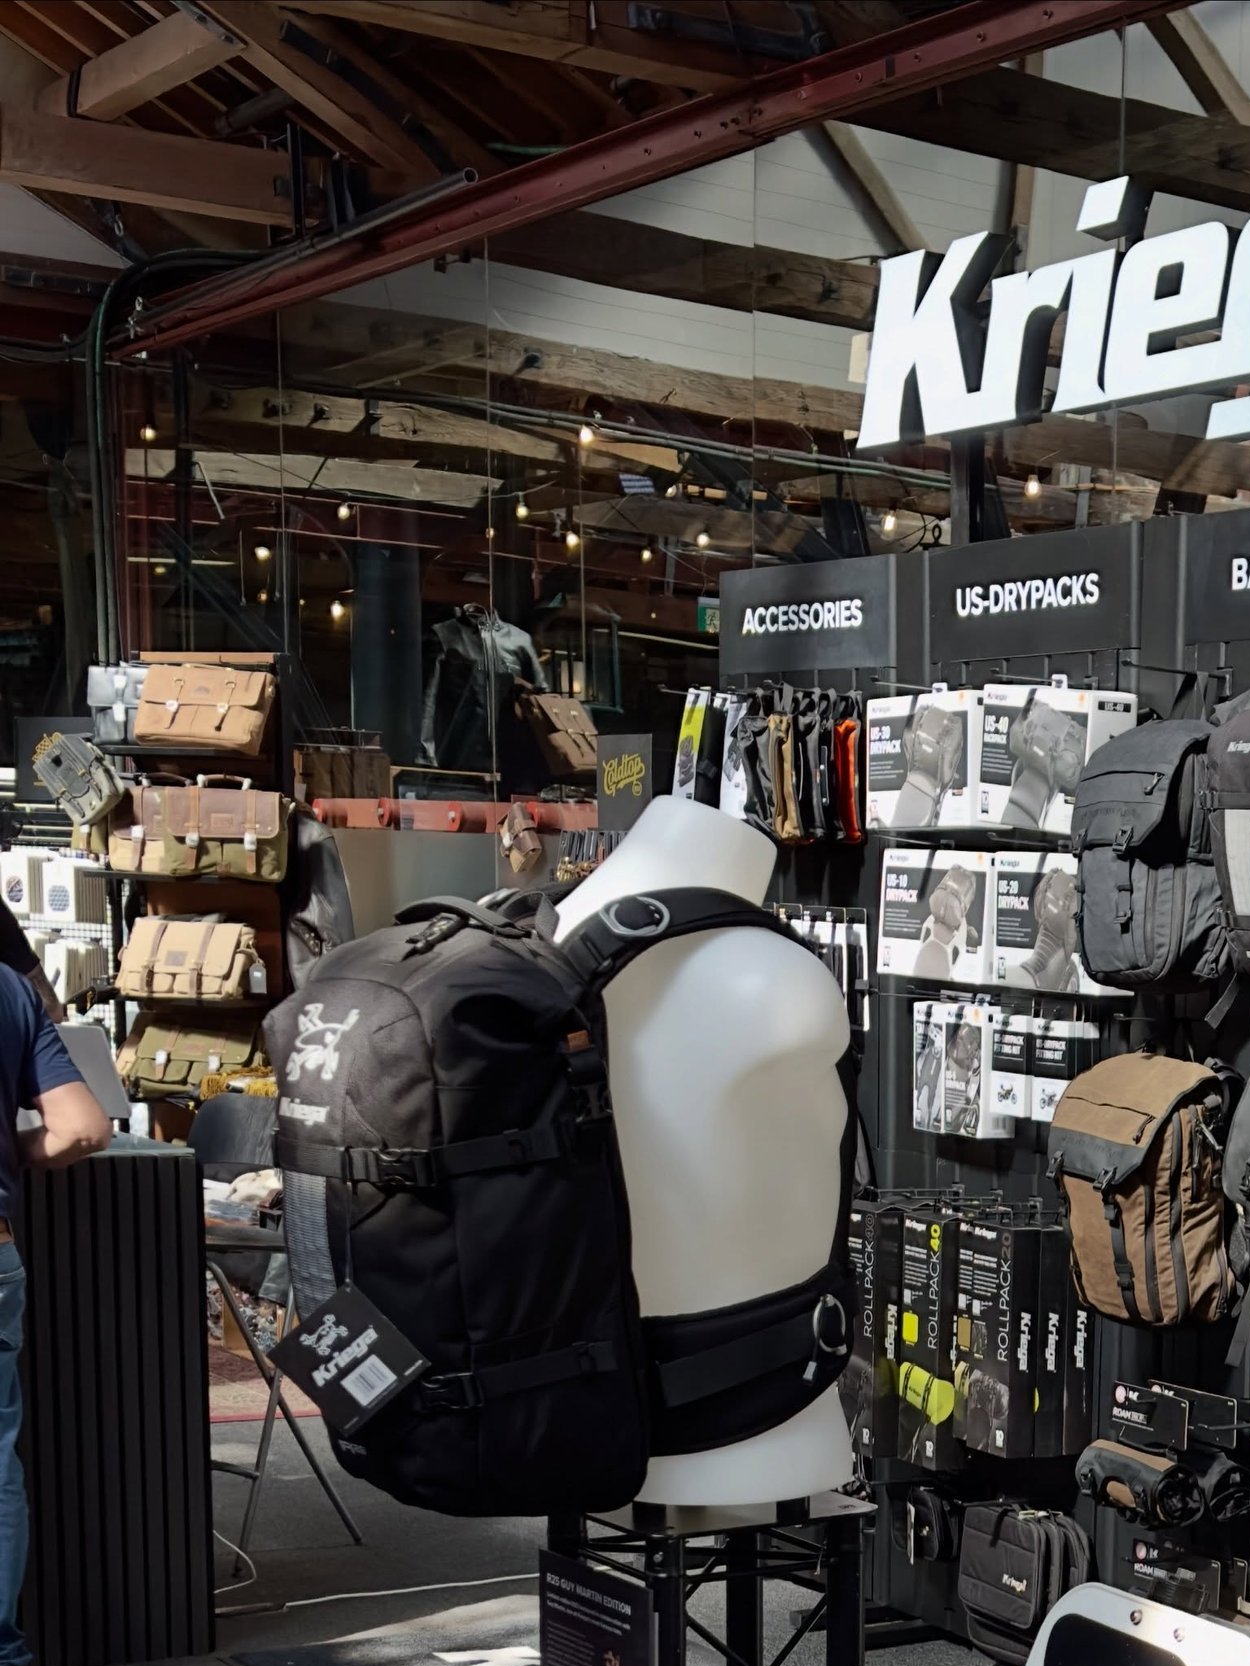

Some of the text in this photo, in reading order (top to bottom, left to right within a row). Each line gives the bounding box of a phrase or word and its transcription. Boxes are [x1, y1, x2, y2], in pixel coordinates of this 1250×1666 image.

[742, 598, 863, 634] ACCESSORIES
[955, 572, 1100, 618] US-DRYPACKS
[985, 715, 1009, 733] US-40
[311, 1328, 378, 1387] Kriega
[885, 1304, 898, 1360] Kriega
[1017, 1311, 1031, 1373] Kriega
[1045, 1312, 1059, 1373] Kriega
[1074, 1310, 1087, 1369] Kriega
[1134, 1563, 1153, 1574] ROAM
[561, 1579, 575, 1592] GUY
[576, 1585, 602, 1603] MARTIN
[603, 1596, 632, 1616] EDITION
